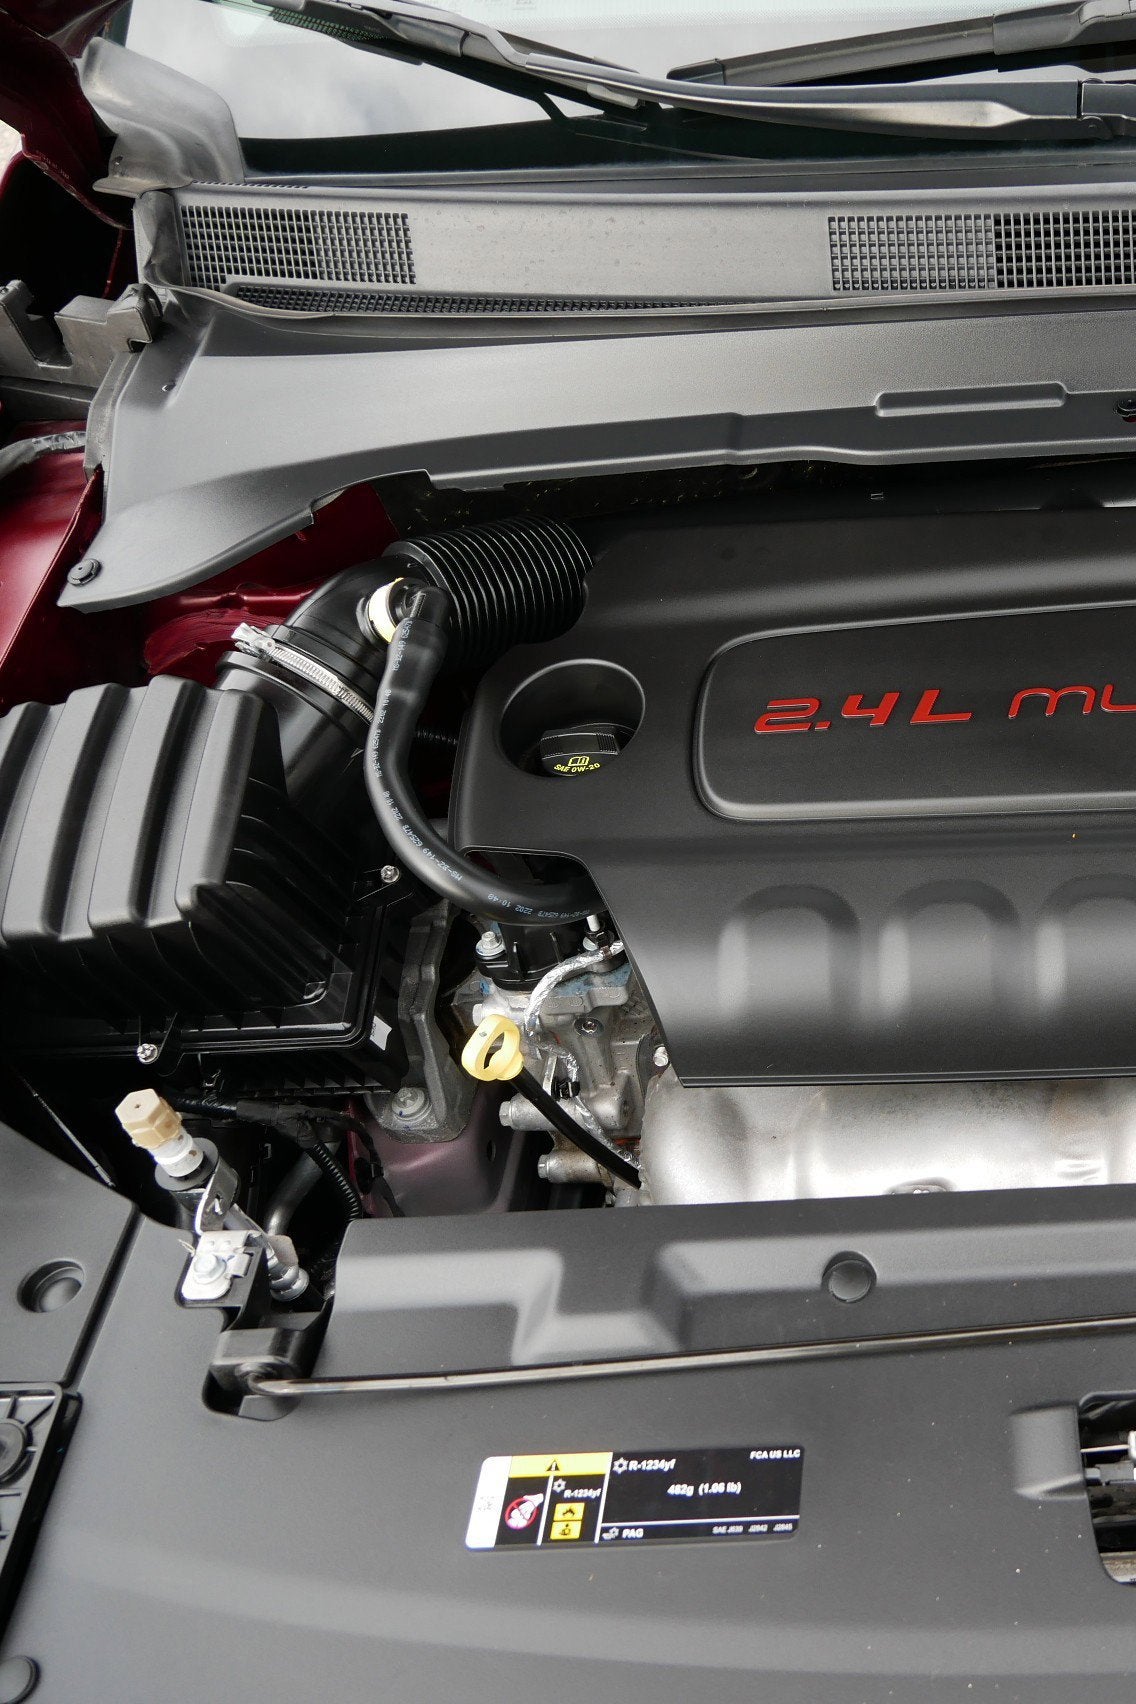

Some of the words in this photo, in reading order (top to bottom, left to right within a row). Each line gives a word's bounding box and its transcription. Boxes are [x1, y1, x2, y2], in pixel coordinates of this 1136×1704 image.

[553, 764, 571, 773] SAE
[571, 762, 601, 773] 0W-20
[750, 1449, 769, 1460] FCA
[769, 1449, 782, 1459] US
[783, 1448, 801, 1459] LLC
[629, 1458, 677, 1472] R-1234yf
[563, 1488, 602, 1500] R-1234yf
[621, 1528, 644, 1539] PAG
